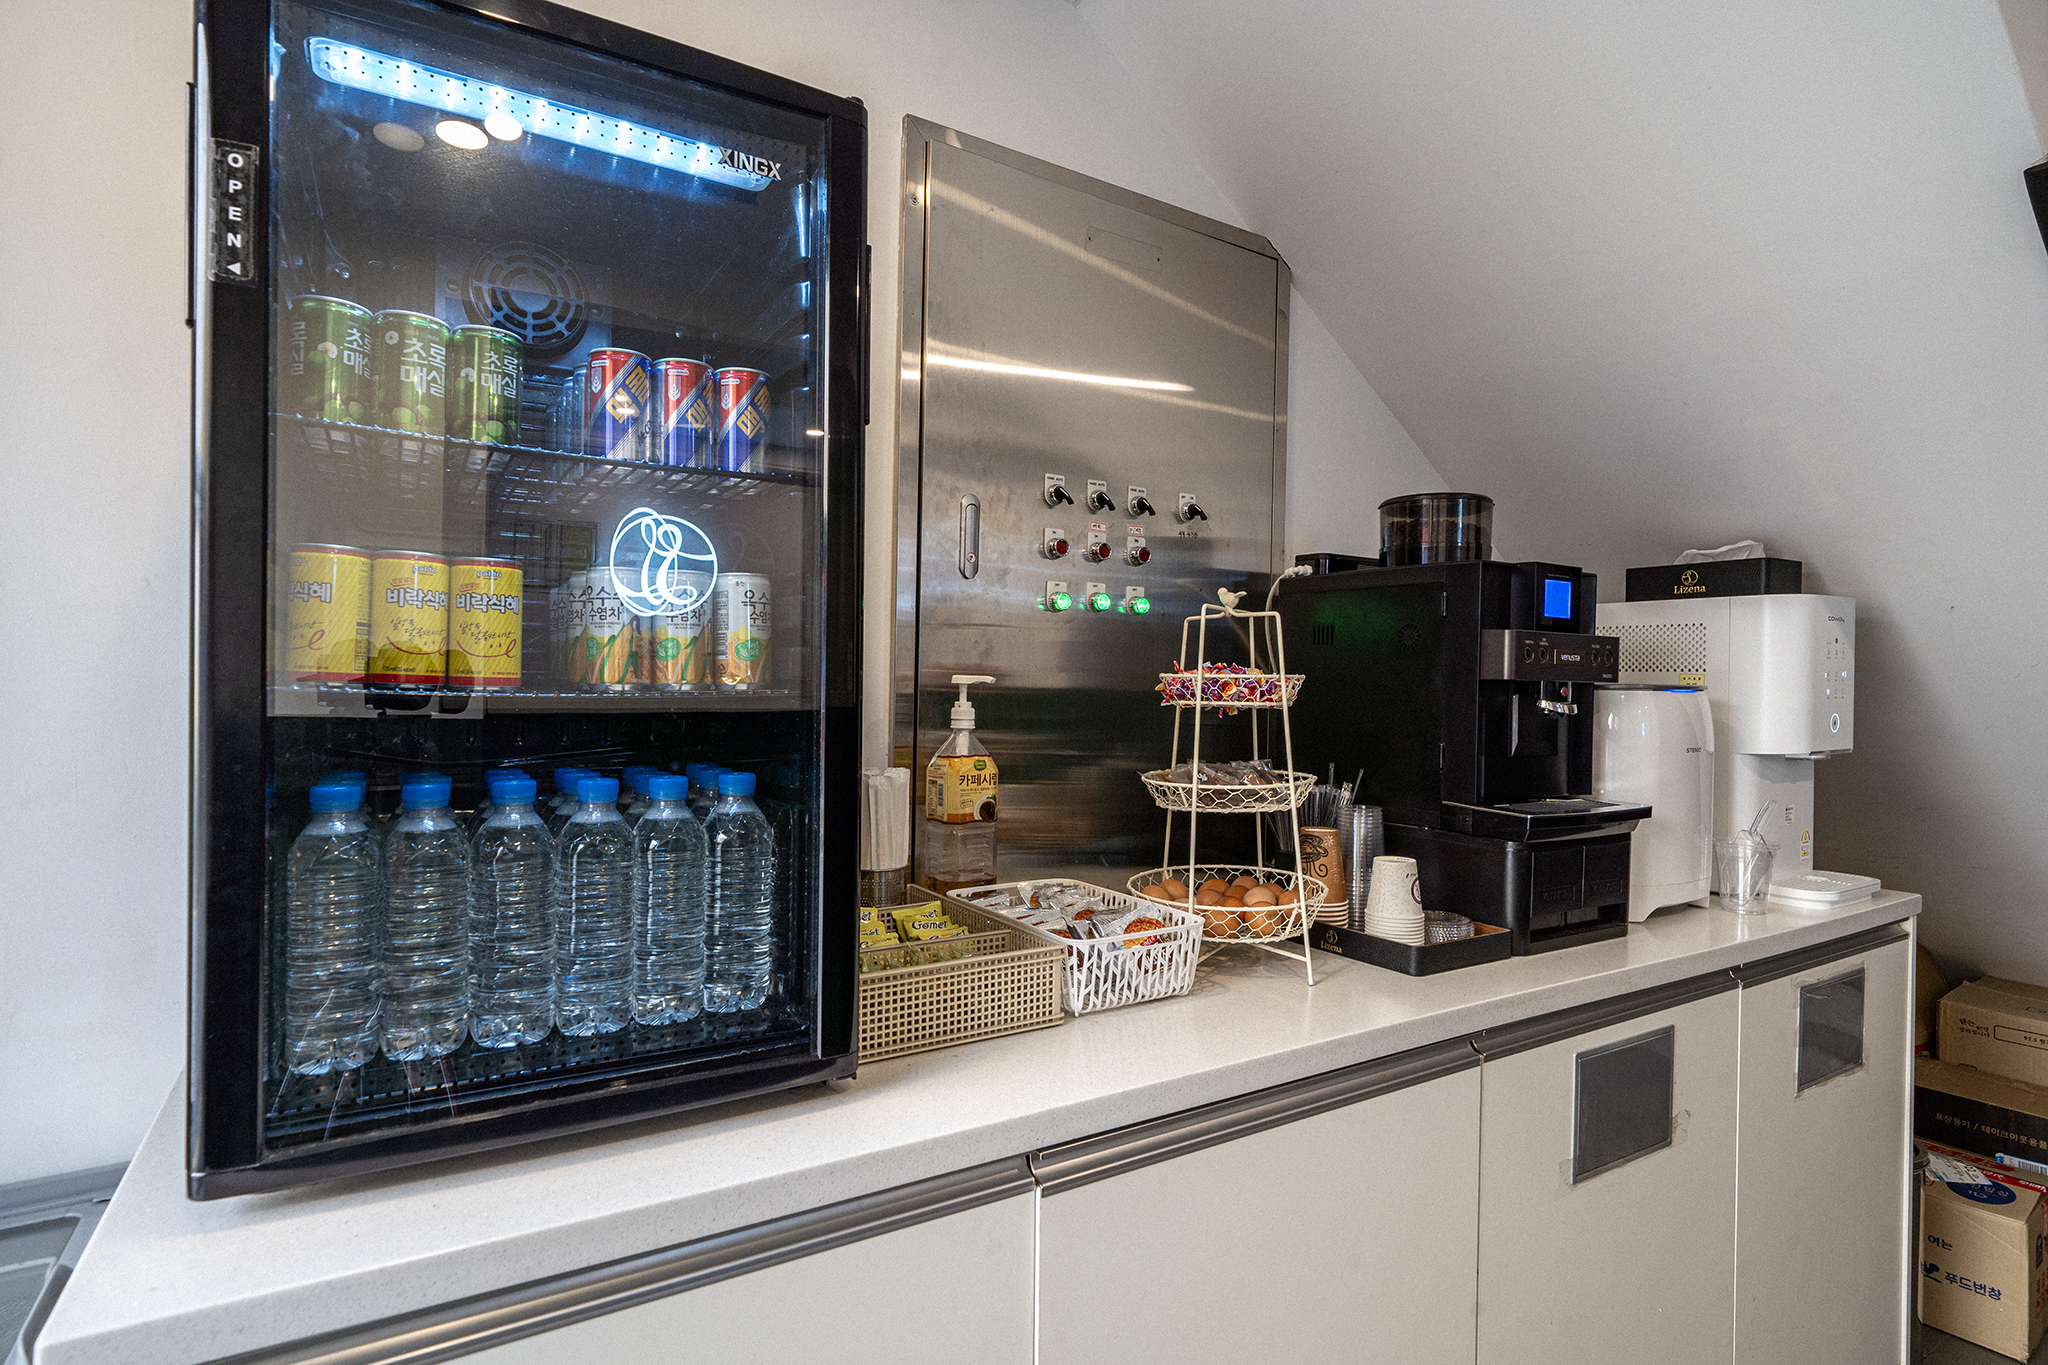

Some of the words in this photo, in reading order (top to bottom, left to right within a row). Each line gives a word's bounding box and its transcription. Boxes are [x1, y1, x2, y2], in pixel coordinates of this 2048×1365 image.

[719, 146, 782, 181] XINGX
[226, 152, 244, 248] OPEN
[400, 337, 447, 373] 초록
[481, 351, 518, 378] 초록
[400, 365, 446, 398] 매실
[480, 372, 517, 399] 매실
[477, 570, 502, 579] paldo
[456, 592, 519, 615] 비락식혜
[1673, 585, 1706, 595] Lizena
[588, 606, 622, 622] 수염차
[1320, 940, 1343, 954] Lizena
[1935, 1112, 1971, 1129] 포장용기
[1981, 1124, 2048, 1150] 테이크아웃용품
[1927, 1234, 1953, 1252] 여는
[1944, 1270, 2003, 1301] 푸드번창
